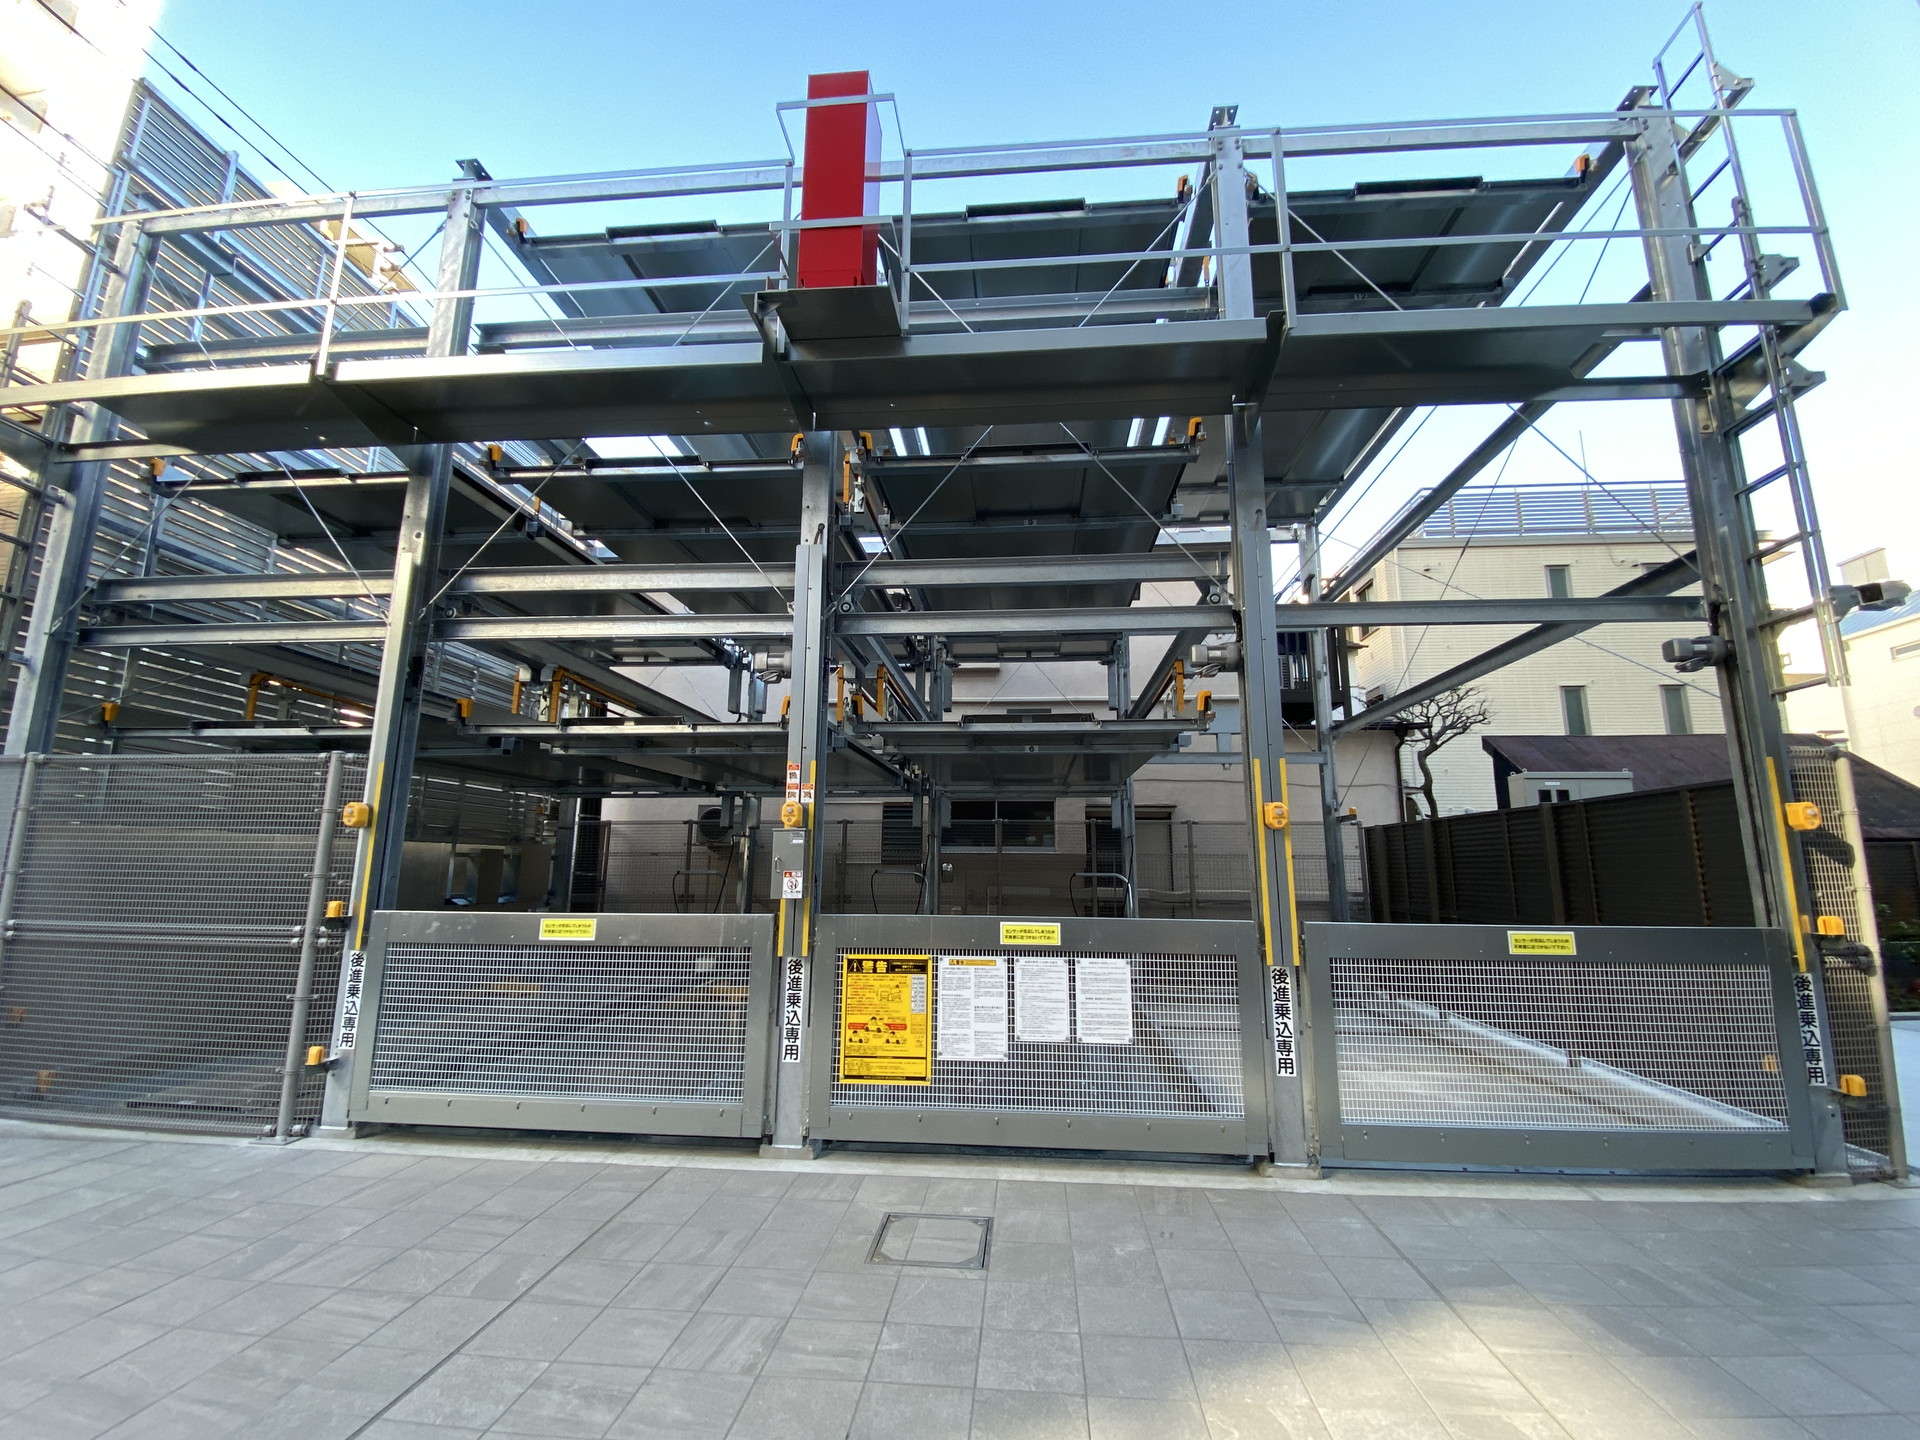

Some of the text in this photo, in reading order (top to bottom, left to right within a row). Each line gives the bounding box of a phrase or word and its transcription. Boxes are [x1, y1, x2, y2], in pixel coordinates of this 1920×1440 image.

[339, 952, 366, 1048] 後進乗込専用
[782, 958, 803, 1061] 後進乗込専用
[862, 960, 888, 973] 警告
[1271, 967, 1295, 1075] 後進乗込専用
[1793, 974, 1825, 1084] 後進乗込専用
